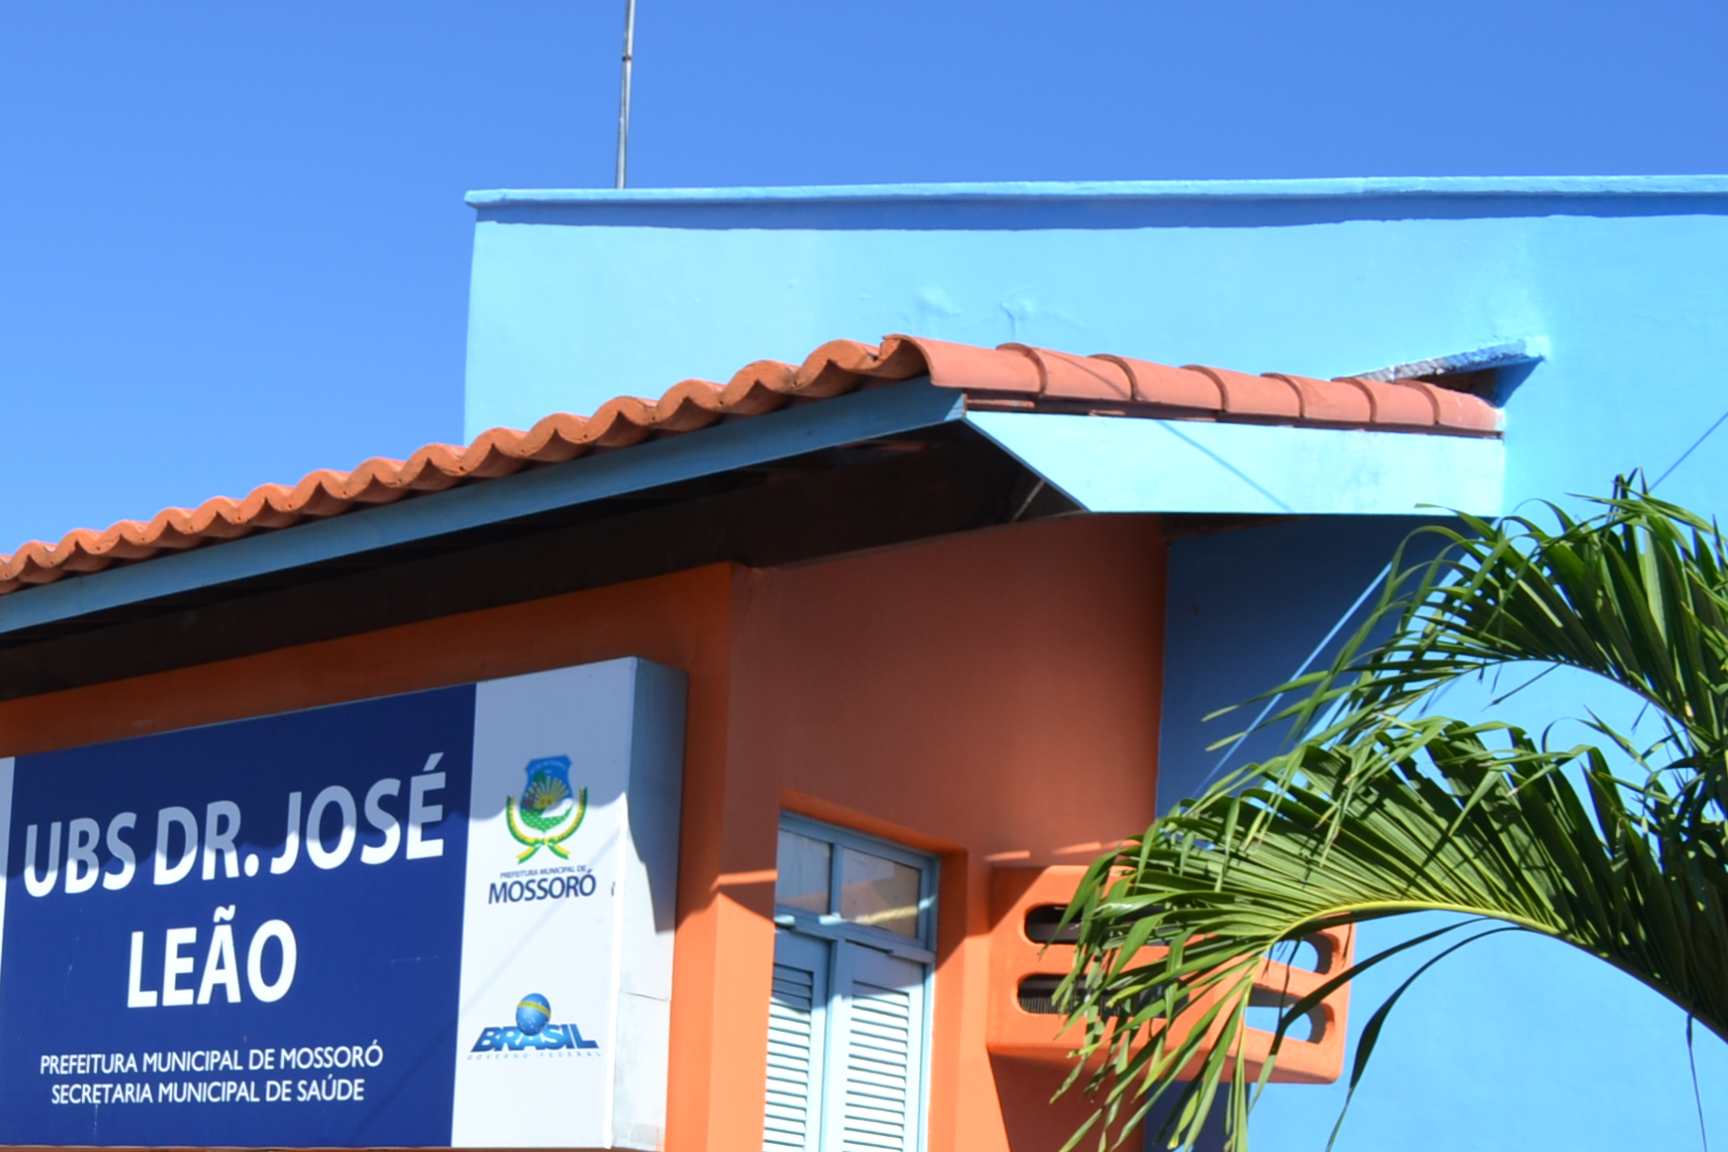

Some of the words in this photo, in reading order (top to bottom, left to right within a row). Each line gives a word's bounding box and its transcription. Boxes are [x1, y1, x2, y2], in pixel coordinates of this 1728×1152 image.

[23, 811, 137, 898] UBS
[500, 868, 538, 879] PREFEITURA
[539, 865, 576, 876] MUNICIPAL
[577, 864, 587, 873] DE
[488, 868, 597, 904] MOSSORÓ
[127, 904, 298, 1008] LEÃO
[470, 1023, 600, 1053] BRASIL
[40, 1053, 138, 1075] PREFEITURA
[142, 1050, 243, 1073] MUNICIPAL
[248, 1048, 275, 1070] DE
[280, 1039, 384, 1070] MOSSORÓ
[51, 1083, 154, 1105] SECRETARIA
[158, 1080, 260, 1103] MUNICIPAL
[266, 1079, 292, 1102] DE
[297, 1073, 365, 1101] SAÚDE
